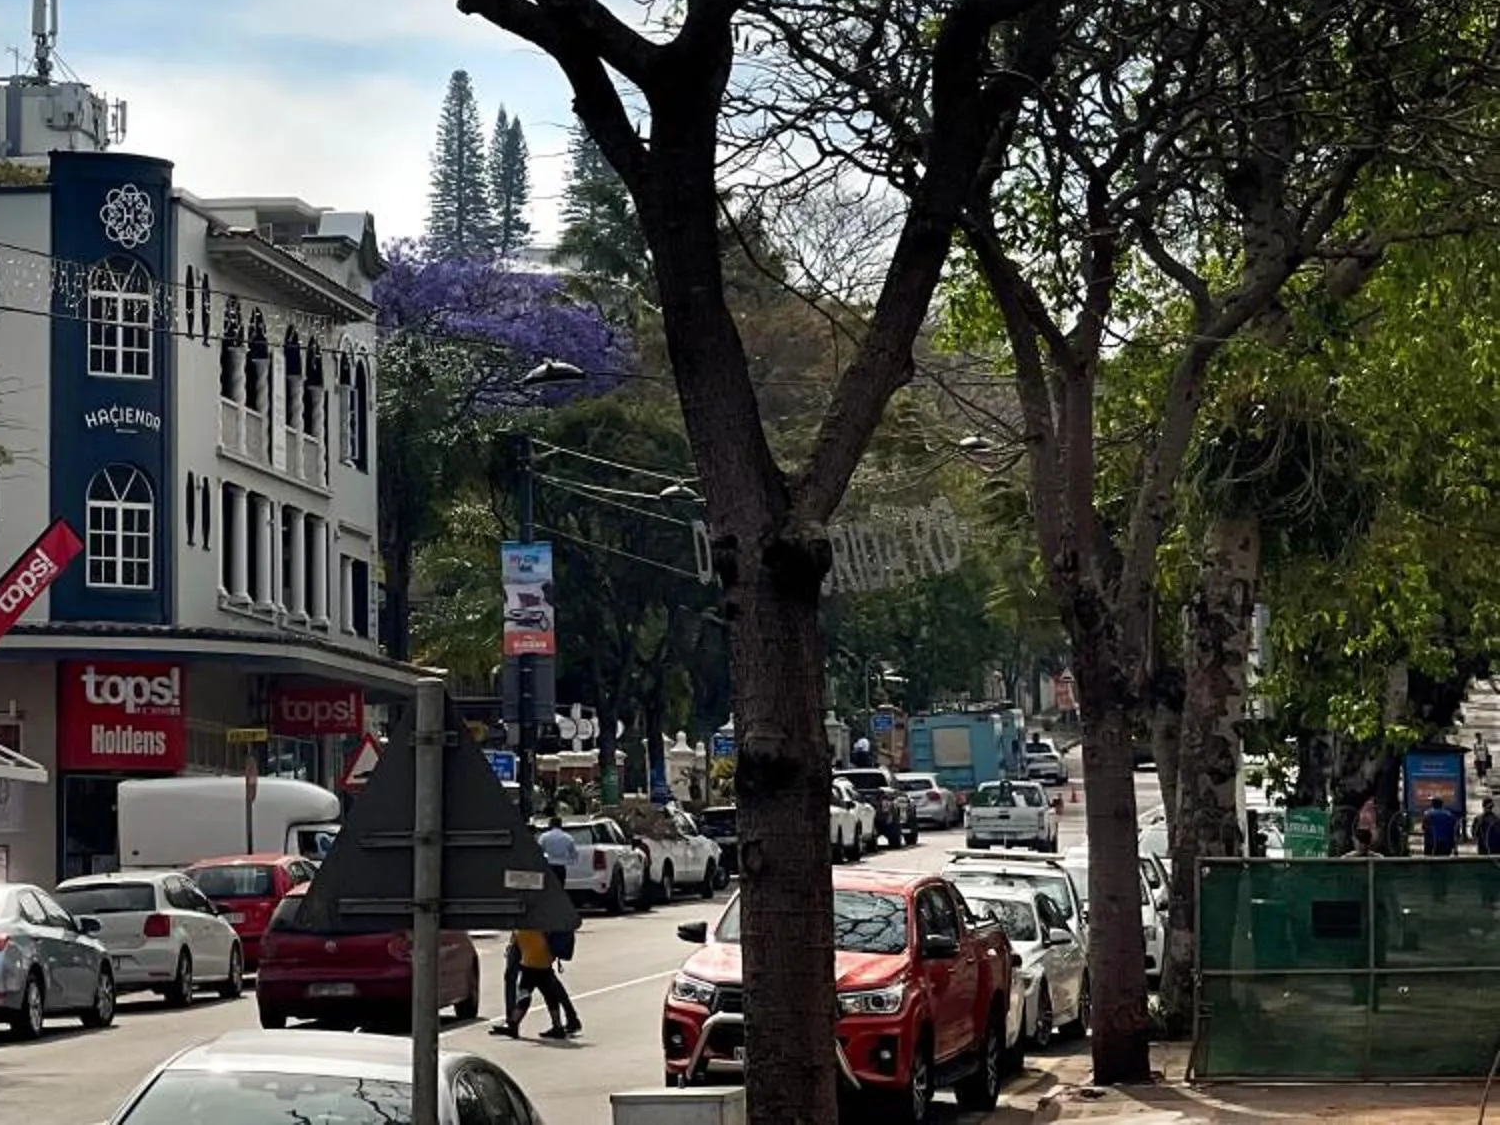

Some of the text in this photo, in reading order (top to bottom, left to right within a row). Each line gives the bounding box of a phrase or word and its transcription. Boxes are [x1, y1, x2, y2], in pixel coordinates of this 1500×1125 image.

[81, 665, 181, 714] tops!
[280, 692, 357, 730] tops!
[91, 724, 167, 755] Holdens
